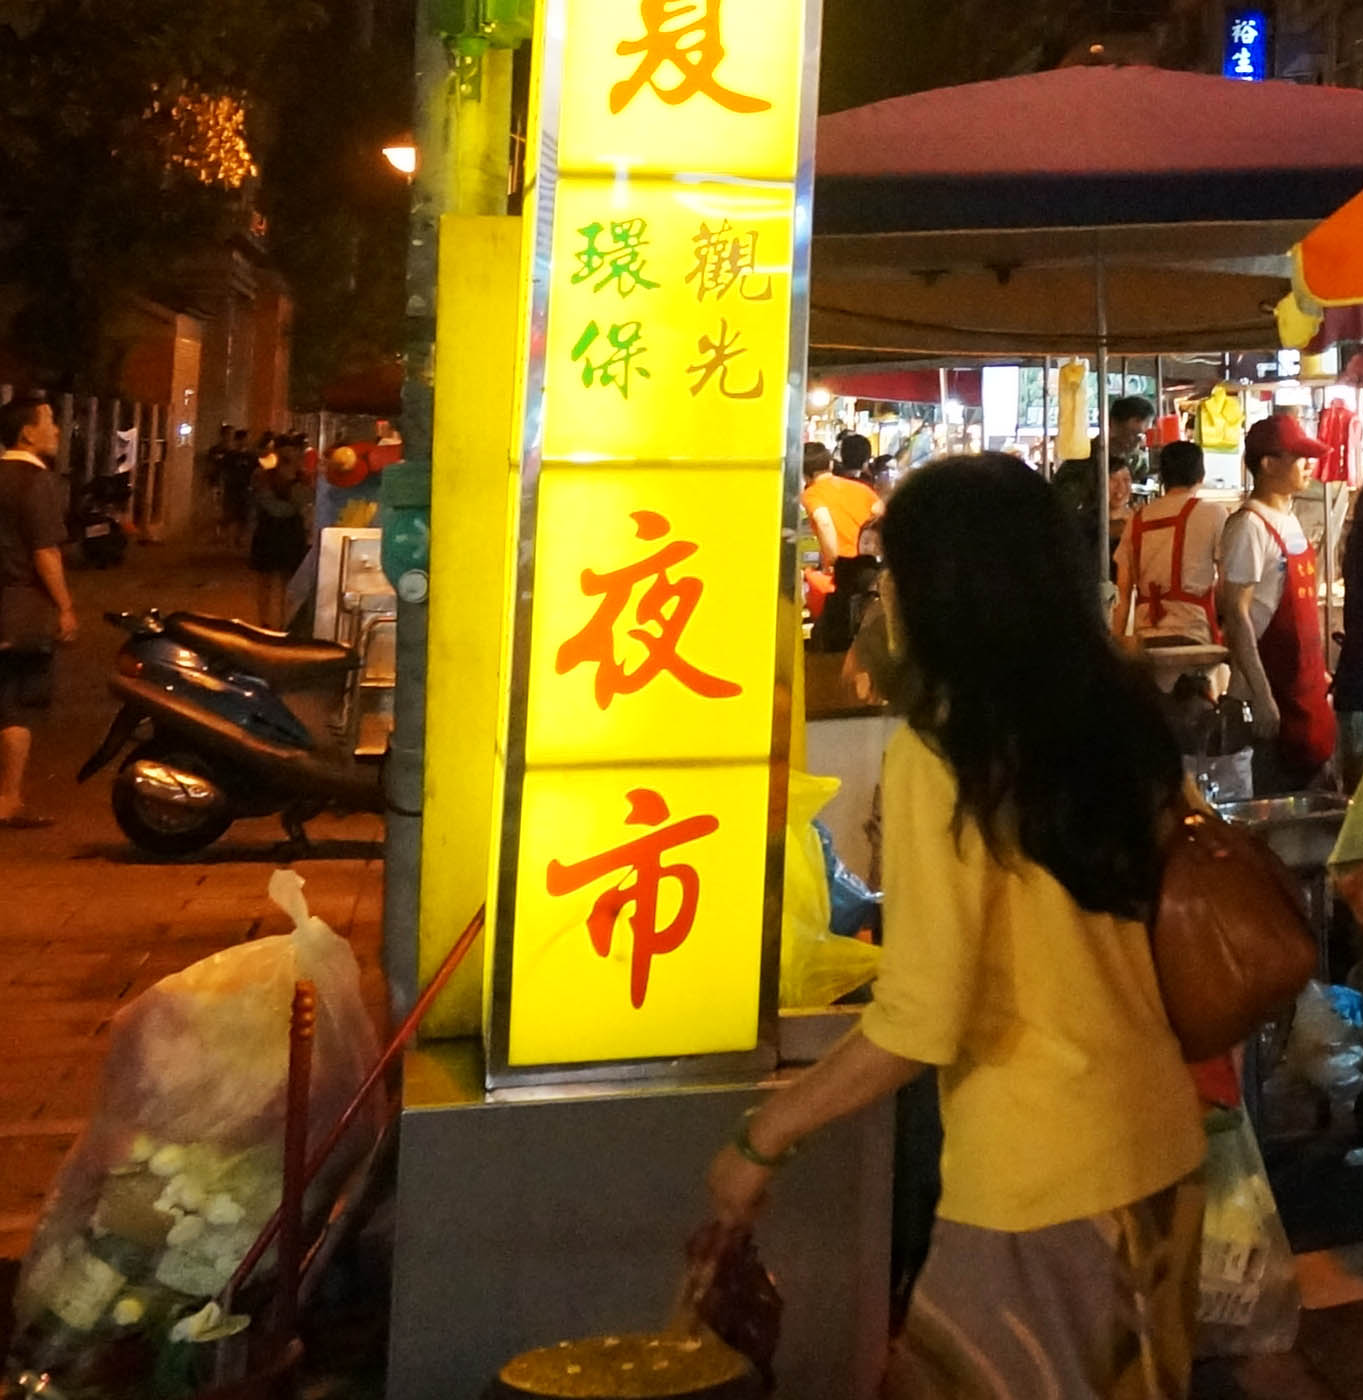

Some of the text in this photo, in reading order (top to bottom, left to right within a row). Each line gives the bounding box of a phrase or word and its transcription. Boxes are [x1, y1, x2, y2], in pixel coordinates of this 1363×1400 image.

[1232, 19, 1258, 81] 裕生
[571, 217, 661, 401] 環保
[685, 219, 773, 401] 觀光
[546, 510, 743, 1009] 夜市
